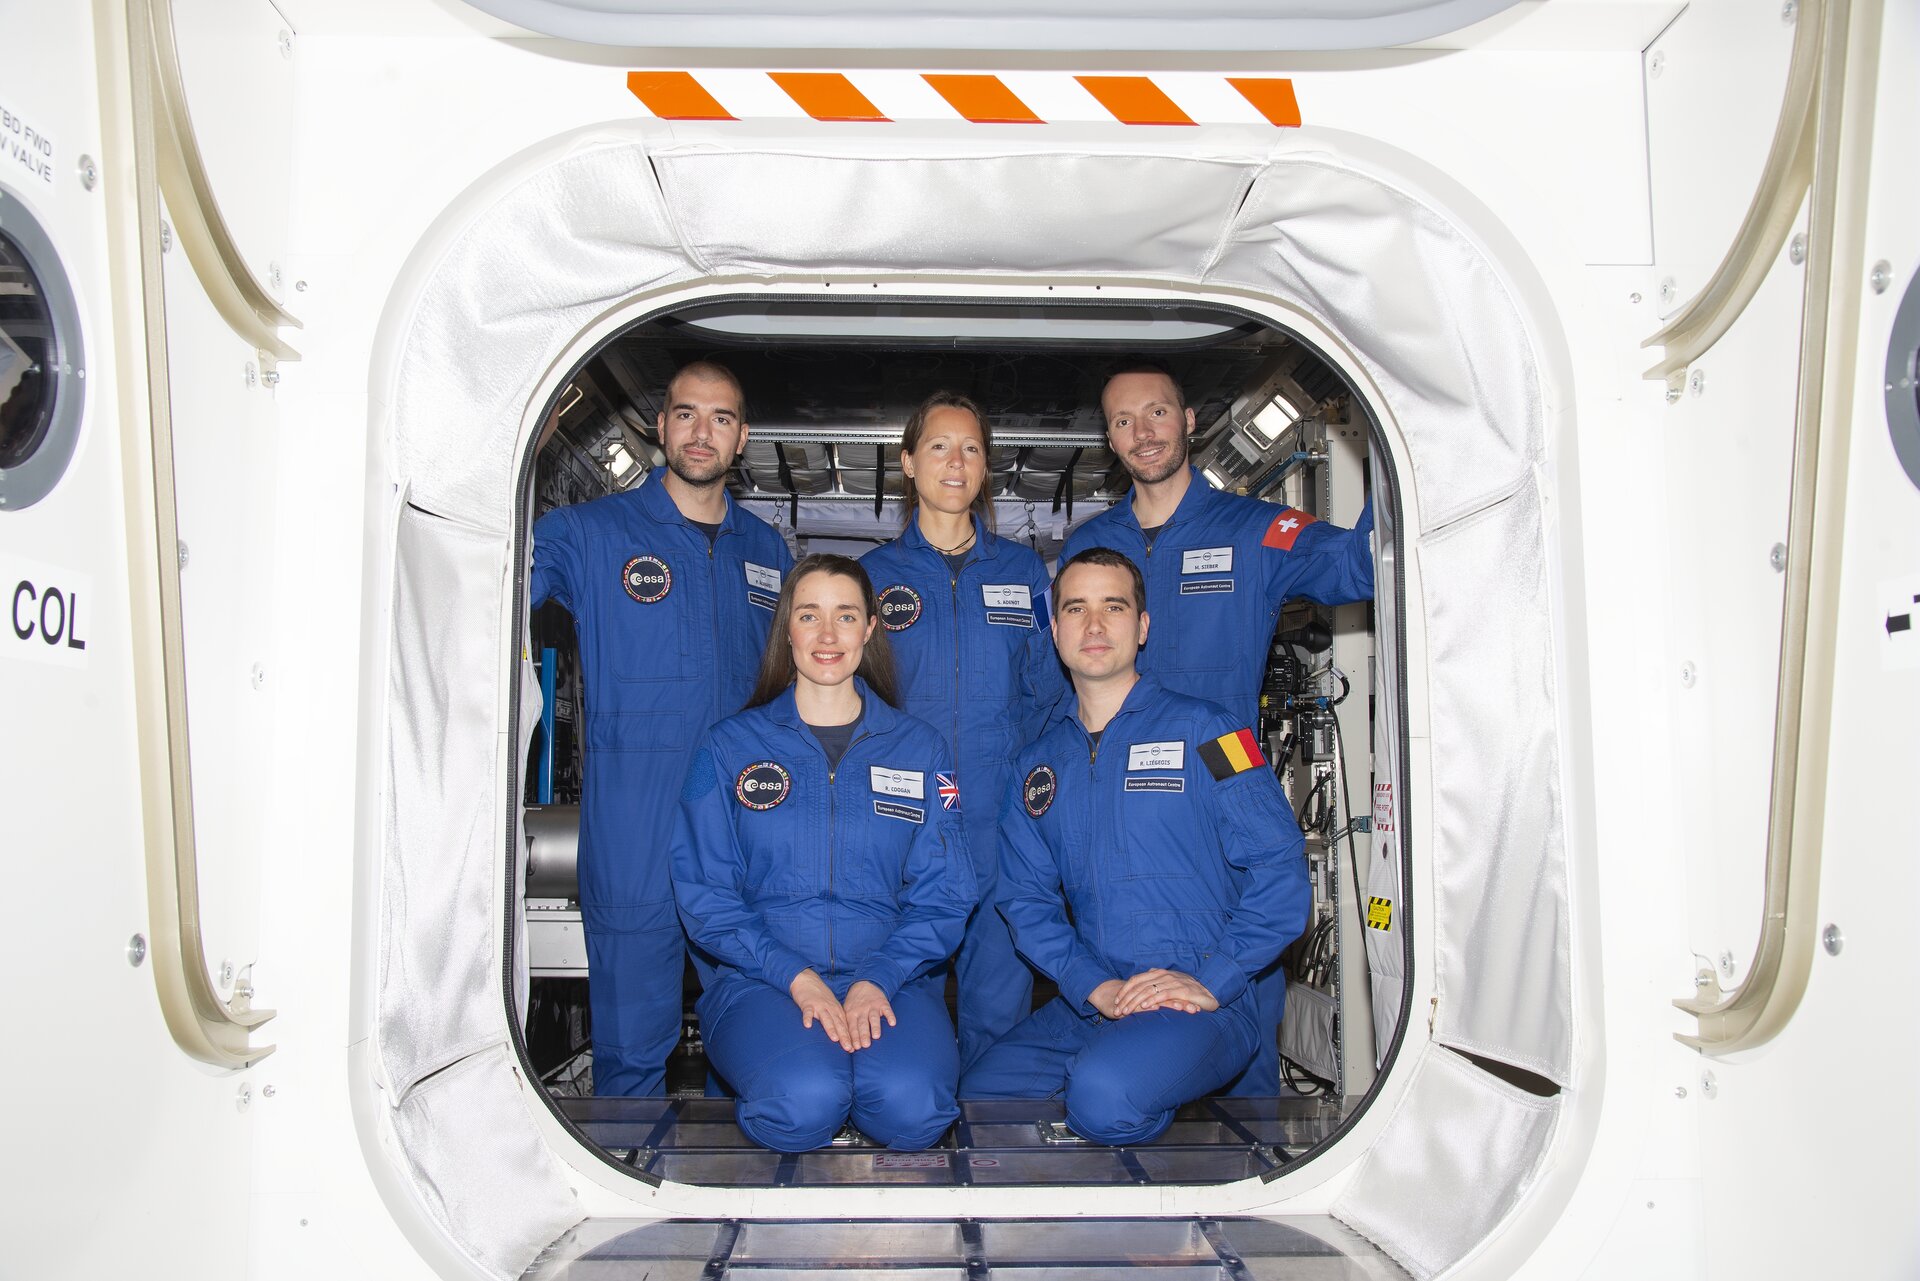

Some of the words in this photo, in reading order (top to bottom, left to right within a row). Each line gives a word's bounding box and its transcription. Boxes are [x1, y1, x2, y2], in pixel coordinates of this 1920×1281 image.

[24, 125, 52, 157] FWD
[11, 140, 52, 183] VALVE
[12, 579, 86, 650] COL
[891, 786, 911, 794] COOGAN
